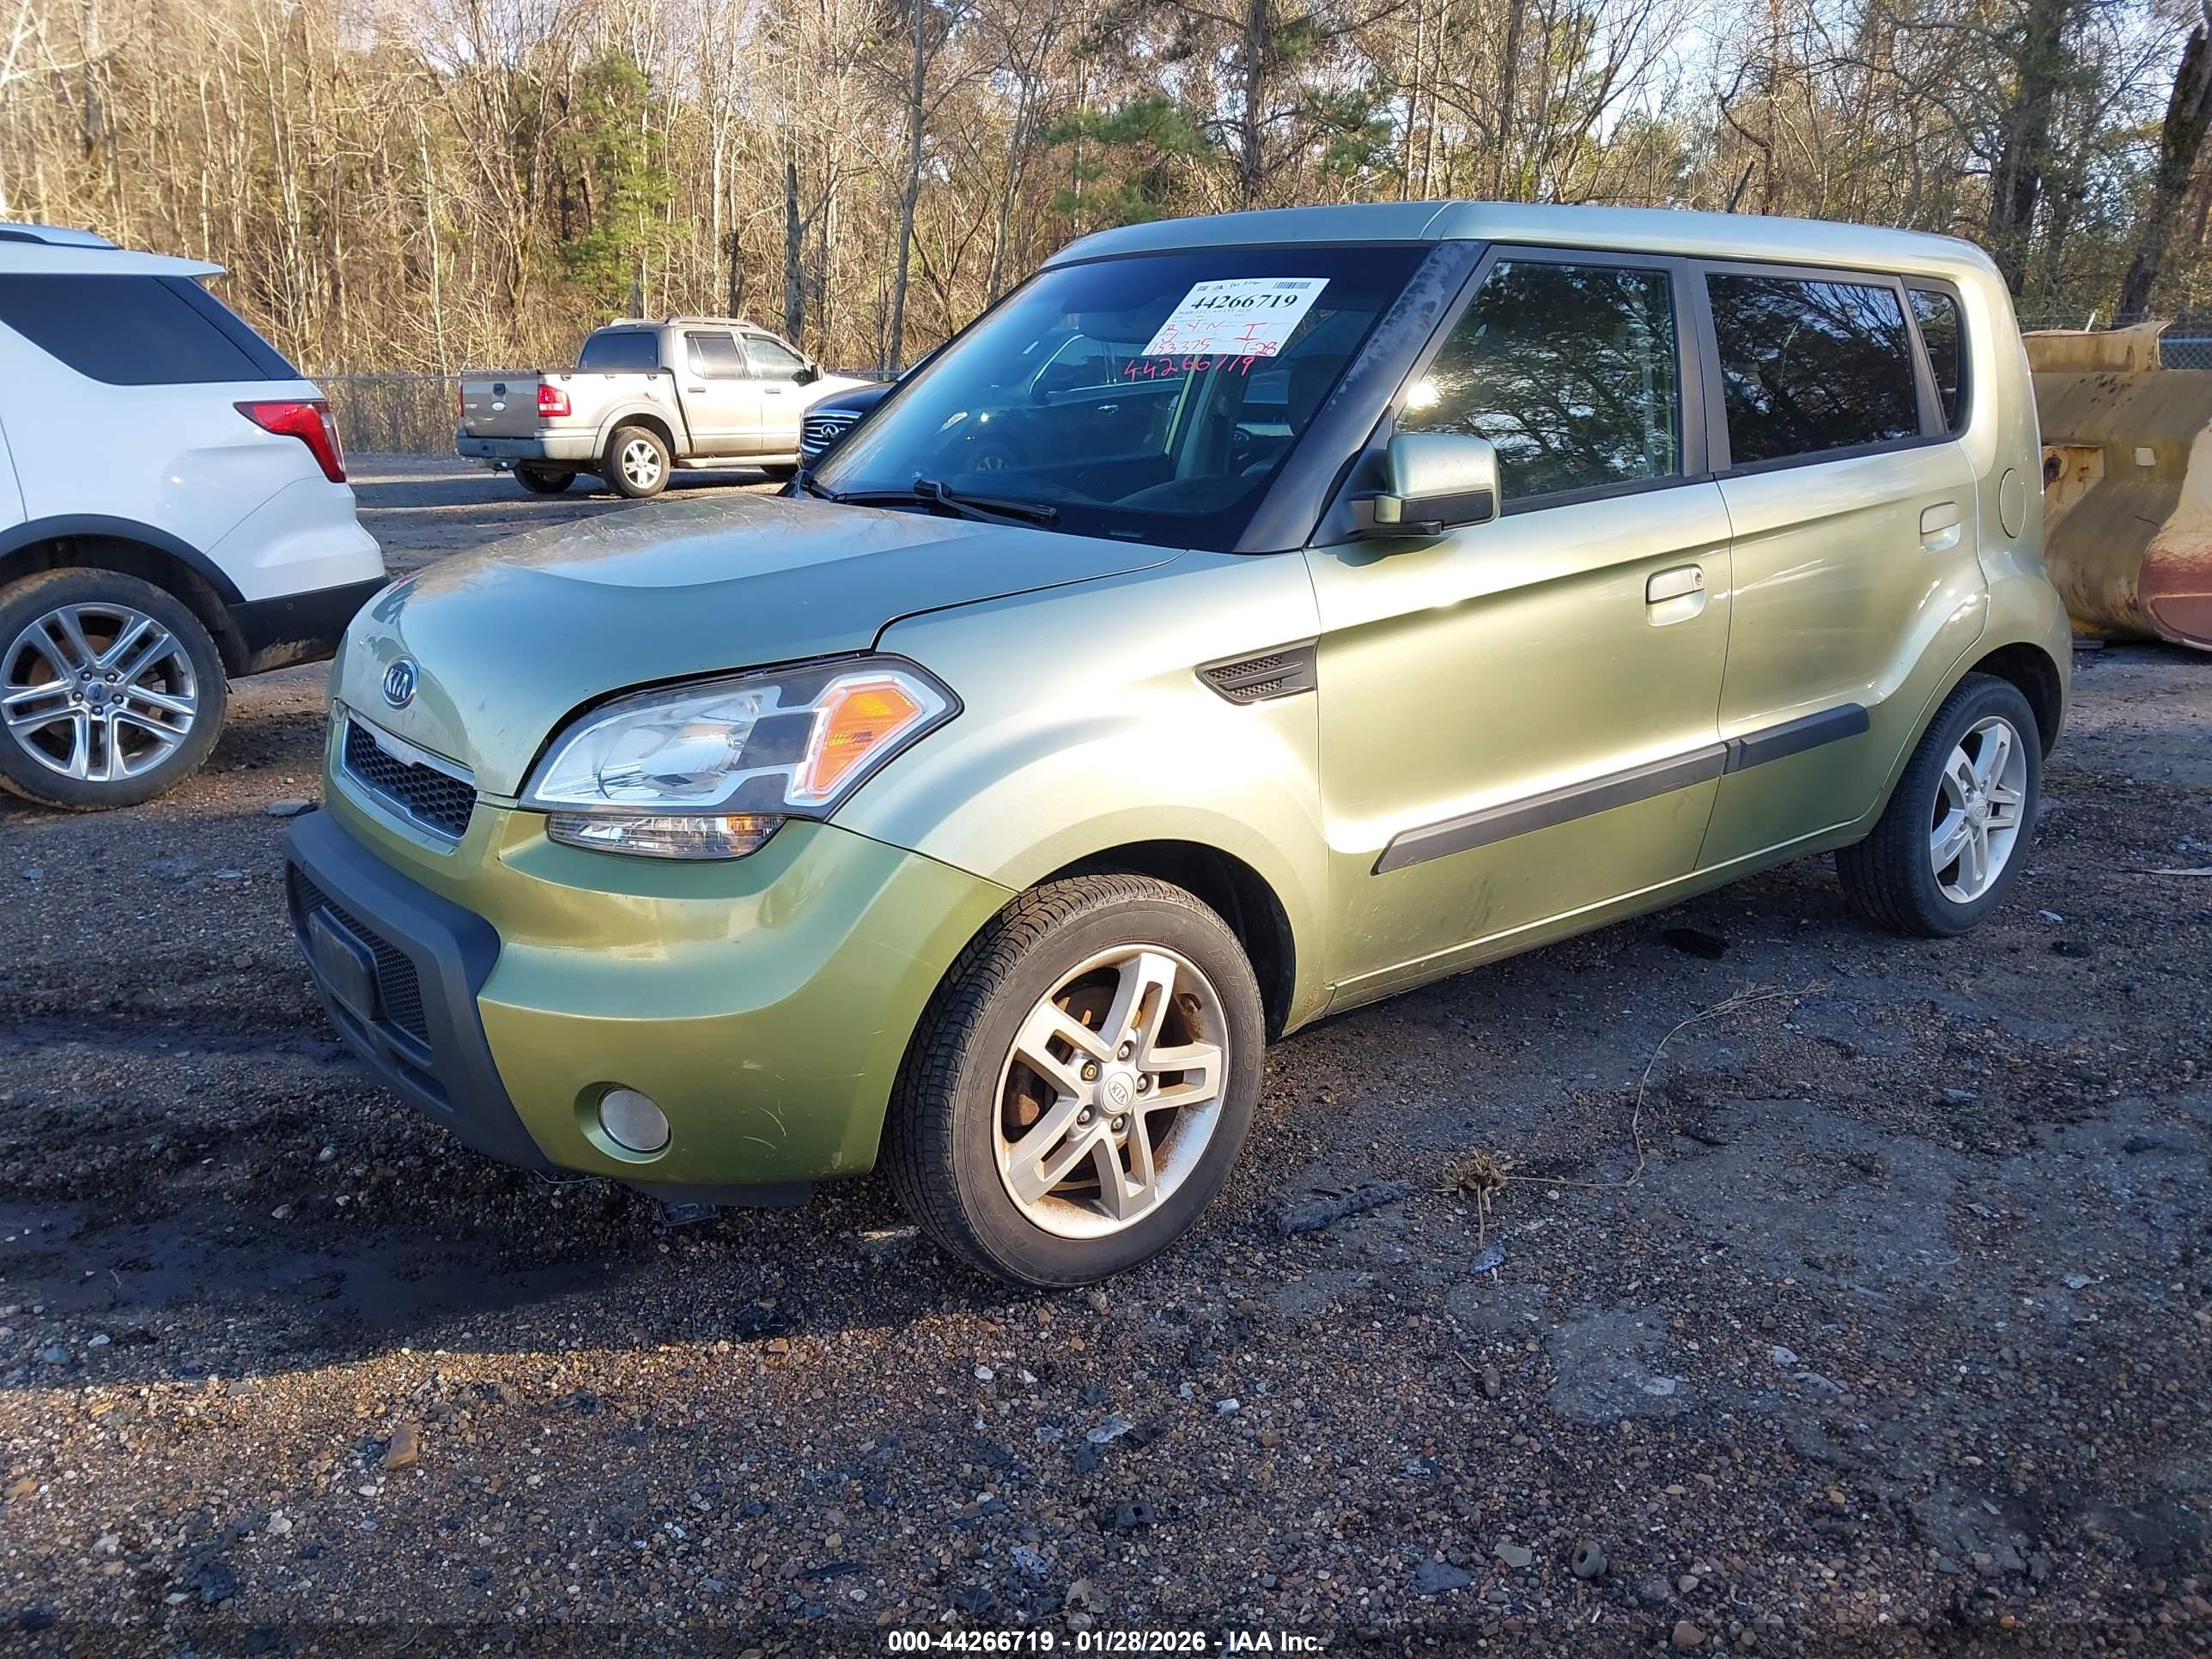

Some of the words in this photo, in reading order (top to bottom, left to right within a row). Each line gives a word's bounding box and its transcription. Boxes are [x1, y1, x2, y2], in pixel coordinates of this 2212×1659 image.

[1190, 294, 1298, 310] 44266719
[1124, 354, 1257, 383] 44266719
[385, 667, 410, 699] KIA
[1110, 1083, 1127, 1103] KIA
